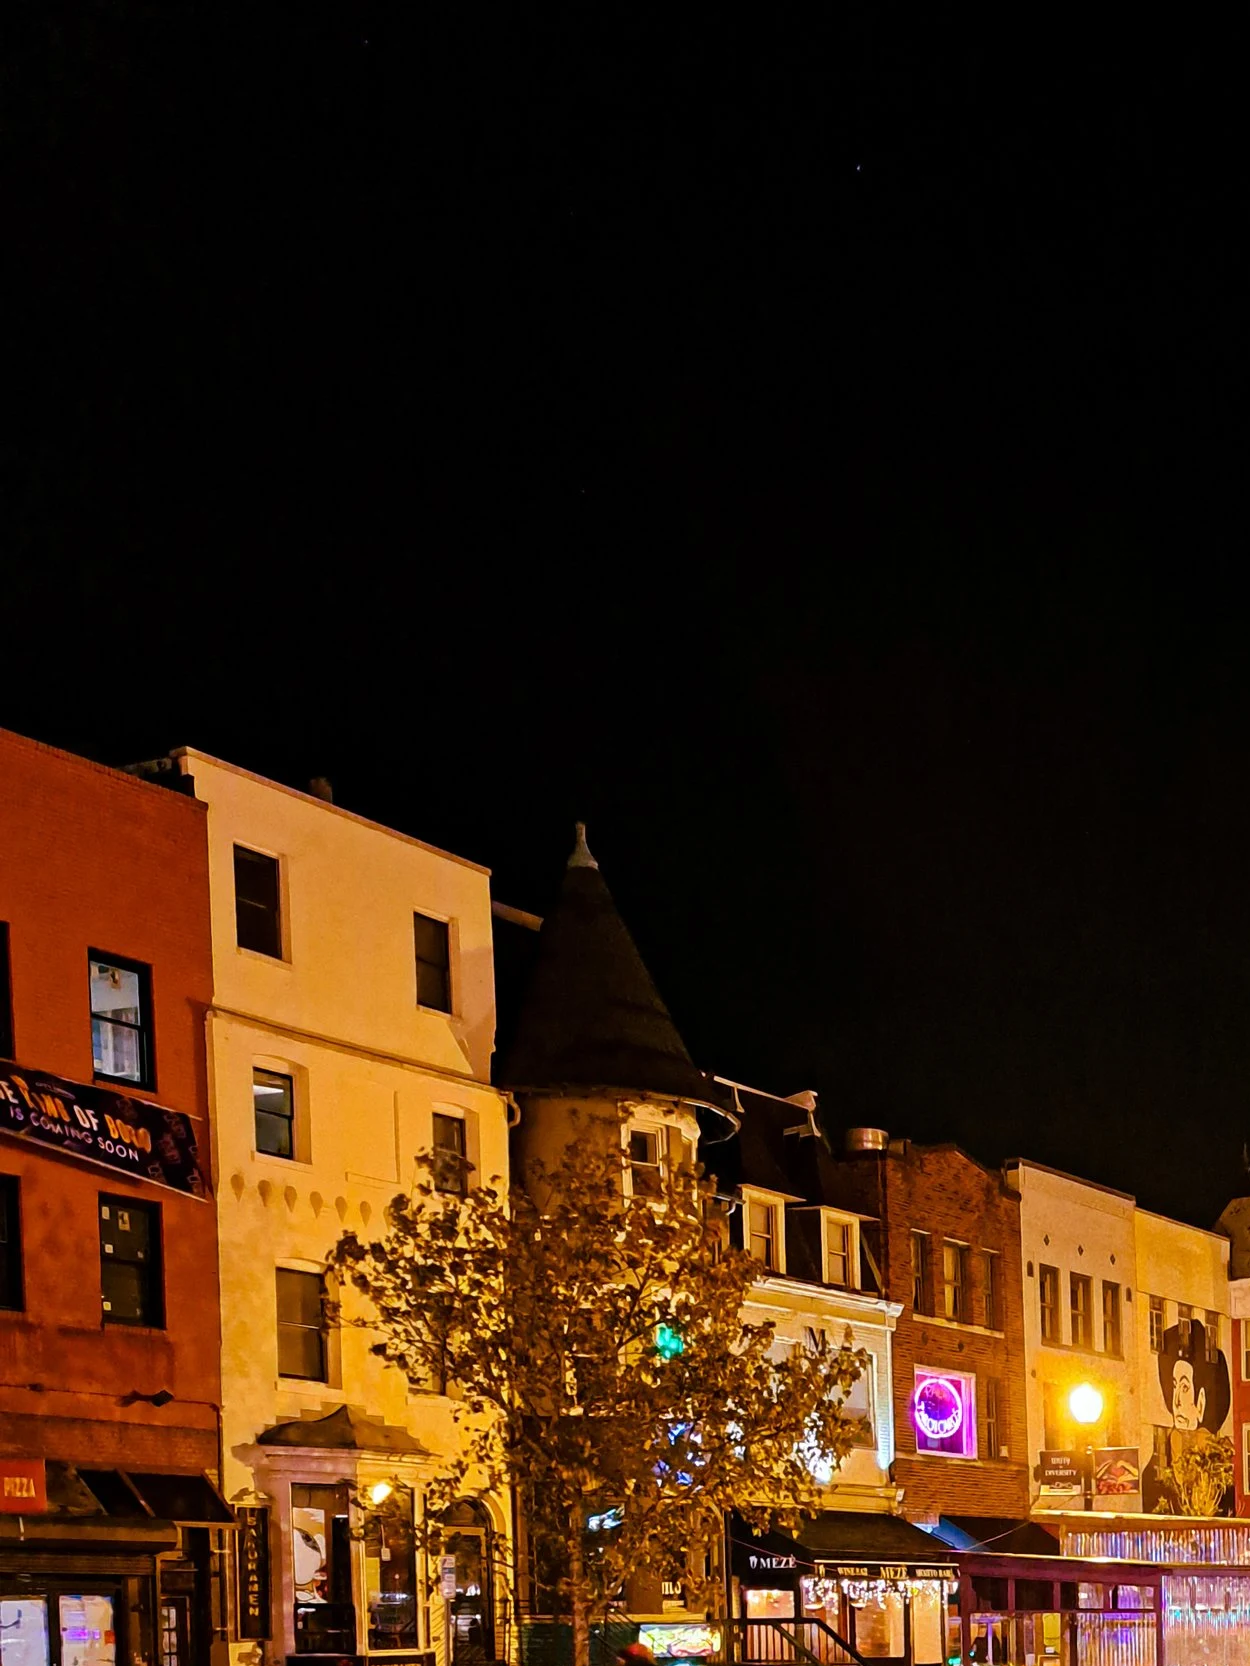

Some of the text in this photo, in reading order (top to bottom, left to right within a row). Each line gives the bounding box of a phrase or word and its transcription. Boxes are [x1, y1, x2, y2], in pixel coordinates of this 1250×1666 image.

[73, 1104, 99, 1132] OF
[10, 1106, 140, 1162] IS COMING SOON
[4, 1476, 36, 1498] PIZZA
